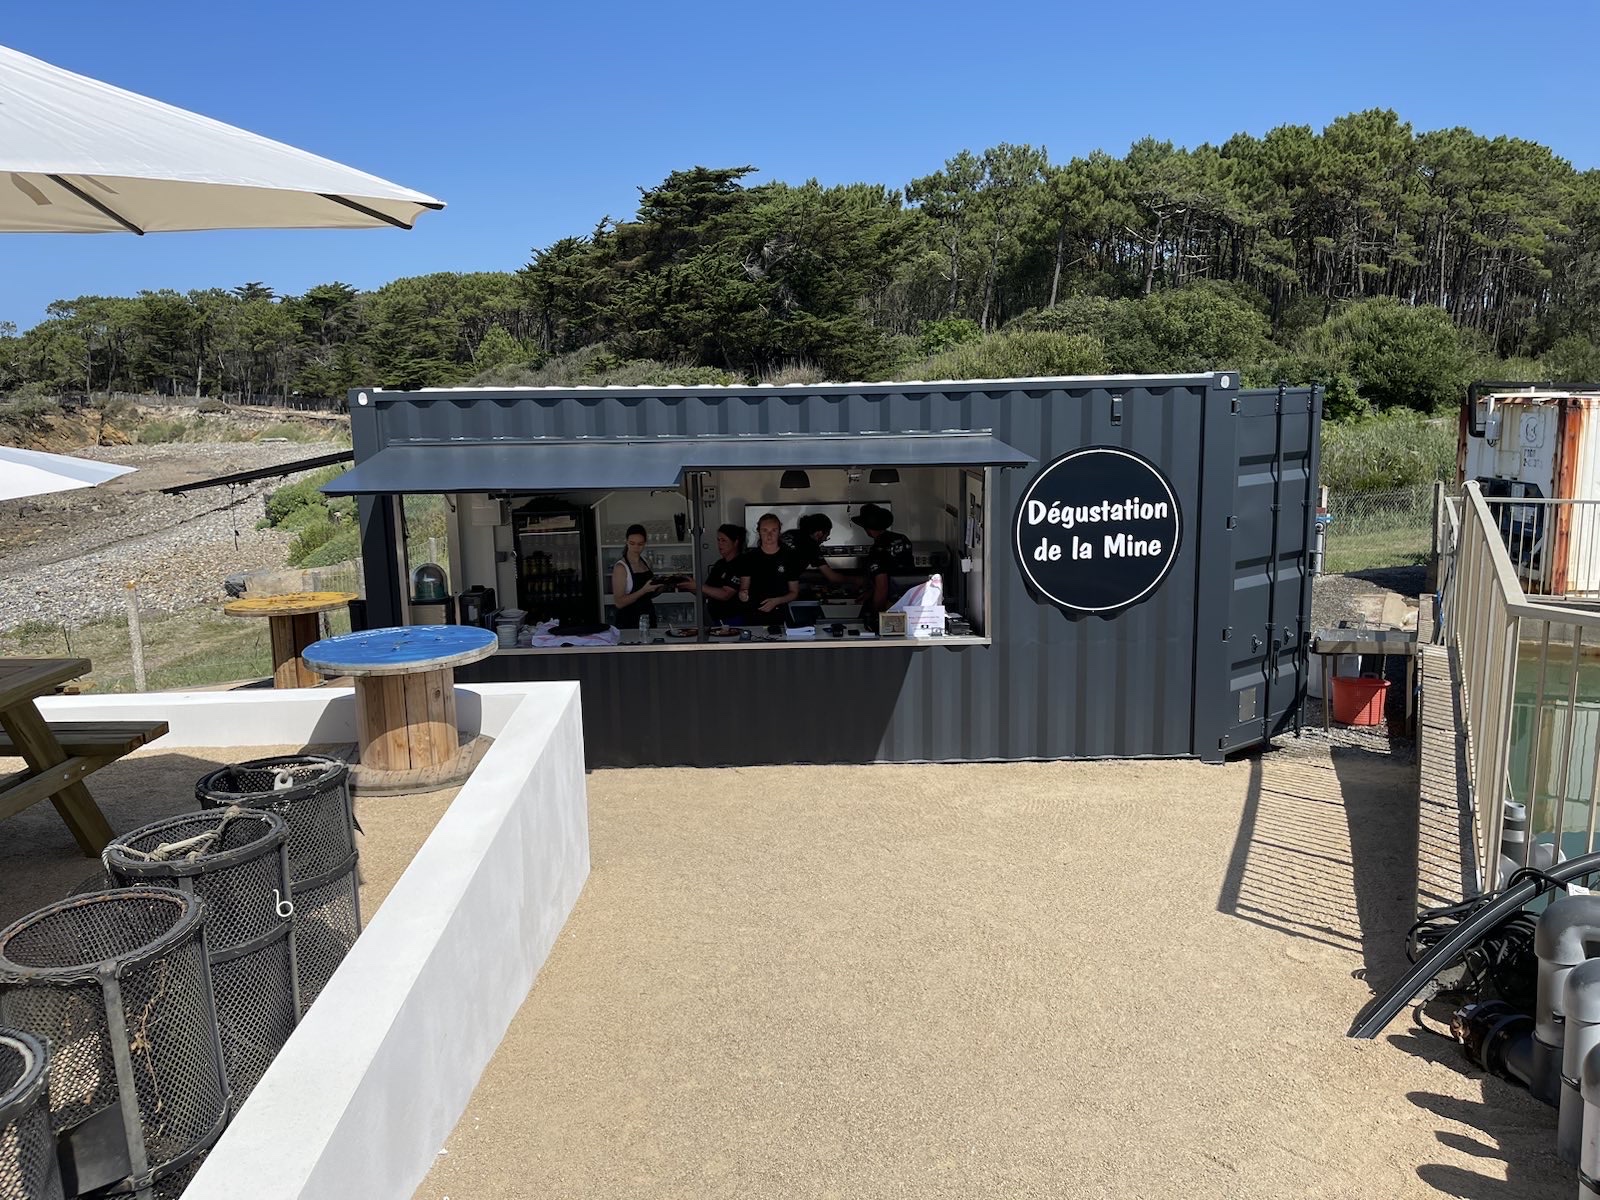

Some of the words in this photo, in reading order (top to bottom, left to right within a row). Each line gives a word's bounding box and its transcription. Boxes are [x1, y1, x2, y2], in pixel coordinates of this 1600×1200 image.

[1028, 497, 1168, 529] Dégustation
[1034, 537, 1062, 561] de
[1072, 536, 1093, 560] la
[1104, 533, 1162, 559] Mine
